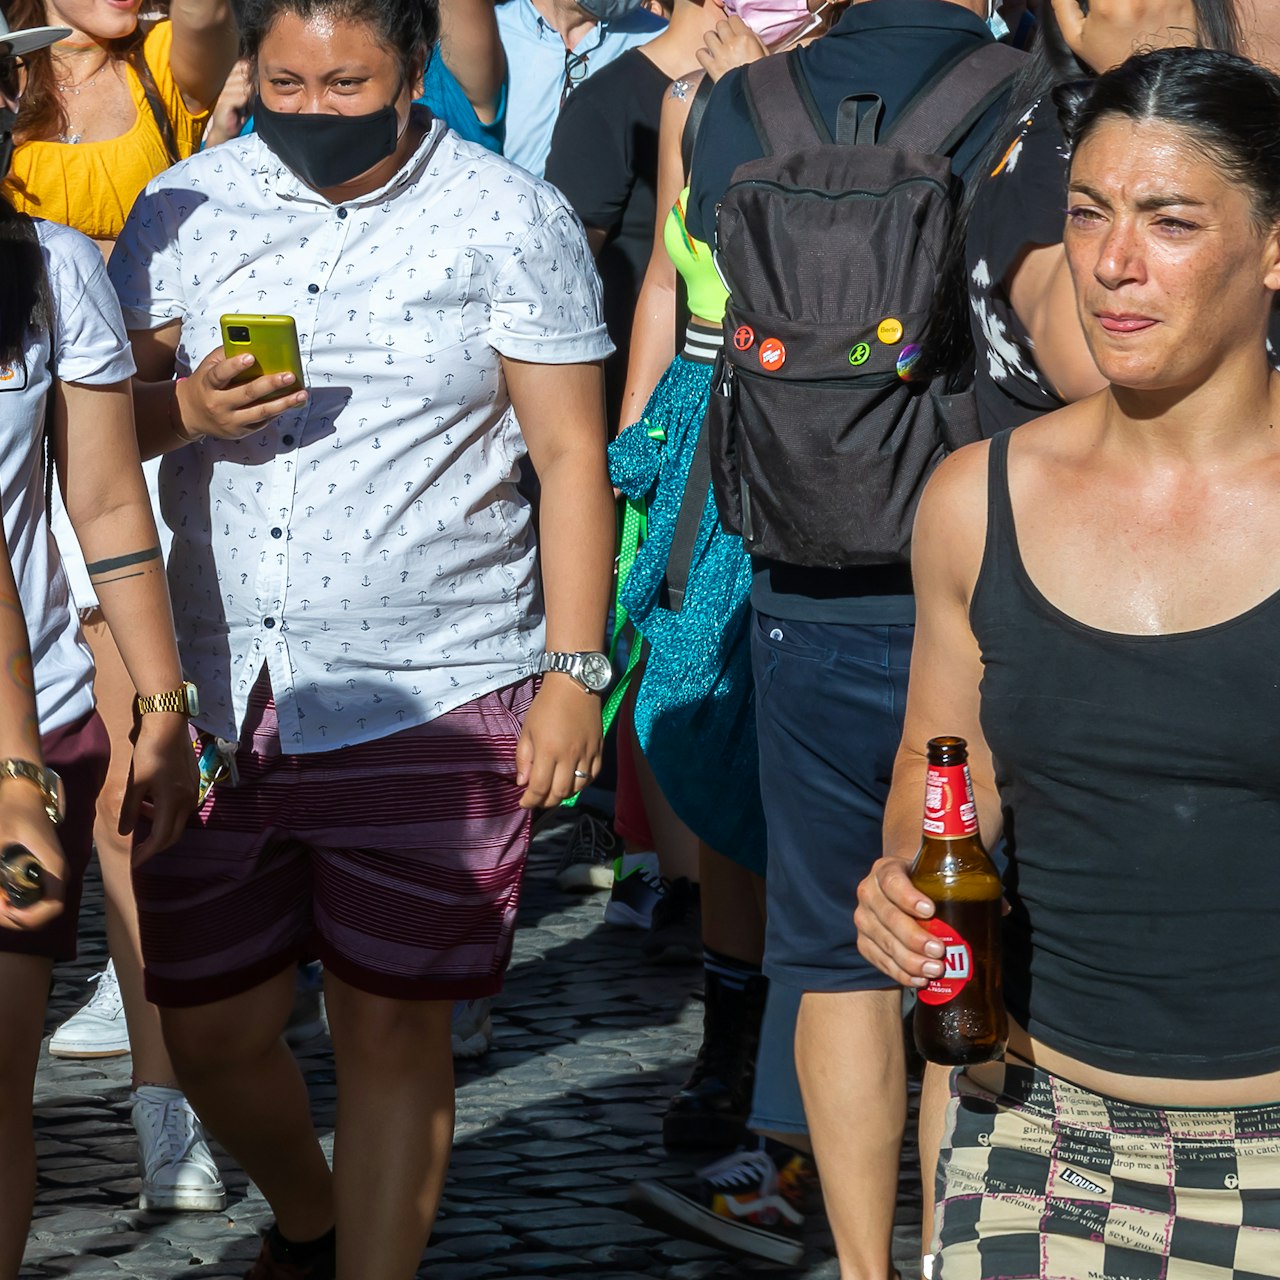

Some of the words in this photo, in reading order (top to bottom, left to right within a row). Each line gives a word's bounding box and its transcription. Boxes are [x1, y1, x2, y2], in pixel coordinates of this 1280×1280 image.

[1074, 1128, 1087, 1138] all
[1088, 1130, 1104, 1139] the
[1112, 1120, 1135, 1128] have
[1143, 1120, 1160, 1130] big
[1020, 1144, 1042, 1154] tired
[1057, 1150, 1091, 1165] paying
[1091, 1155, 1111, 1166] rent
[1113, 1158, 1135, 1170] drop
[1137, 1161, 1152, 1170] me
[1070, 1141, 1085, 1150] her
[1199, 1152, 1218, 1162] you
[1244, 1147, 1254, 1156] to
[1060, 1169, 1104, 1195] LIQUOR
[1083, 1209, 1100, 1219] for
[1107, 1218, 1128, 1228] girl
[1128, 1224, 1150, 1238] who
[1108, 1230, 1133, 1245] sexy
